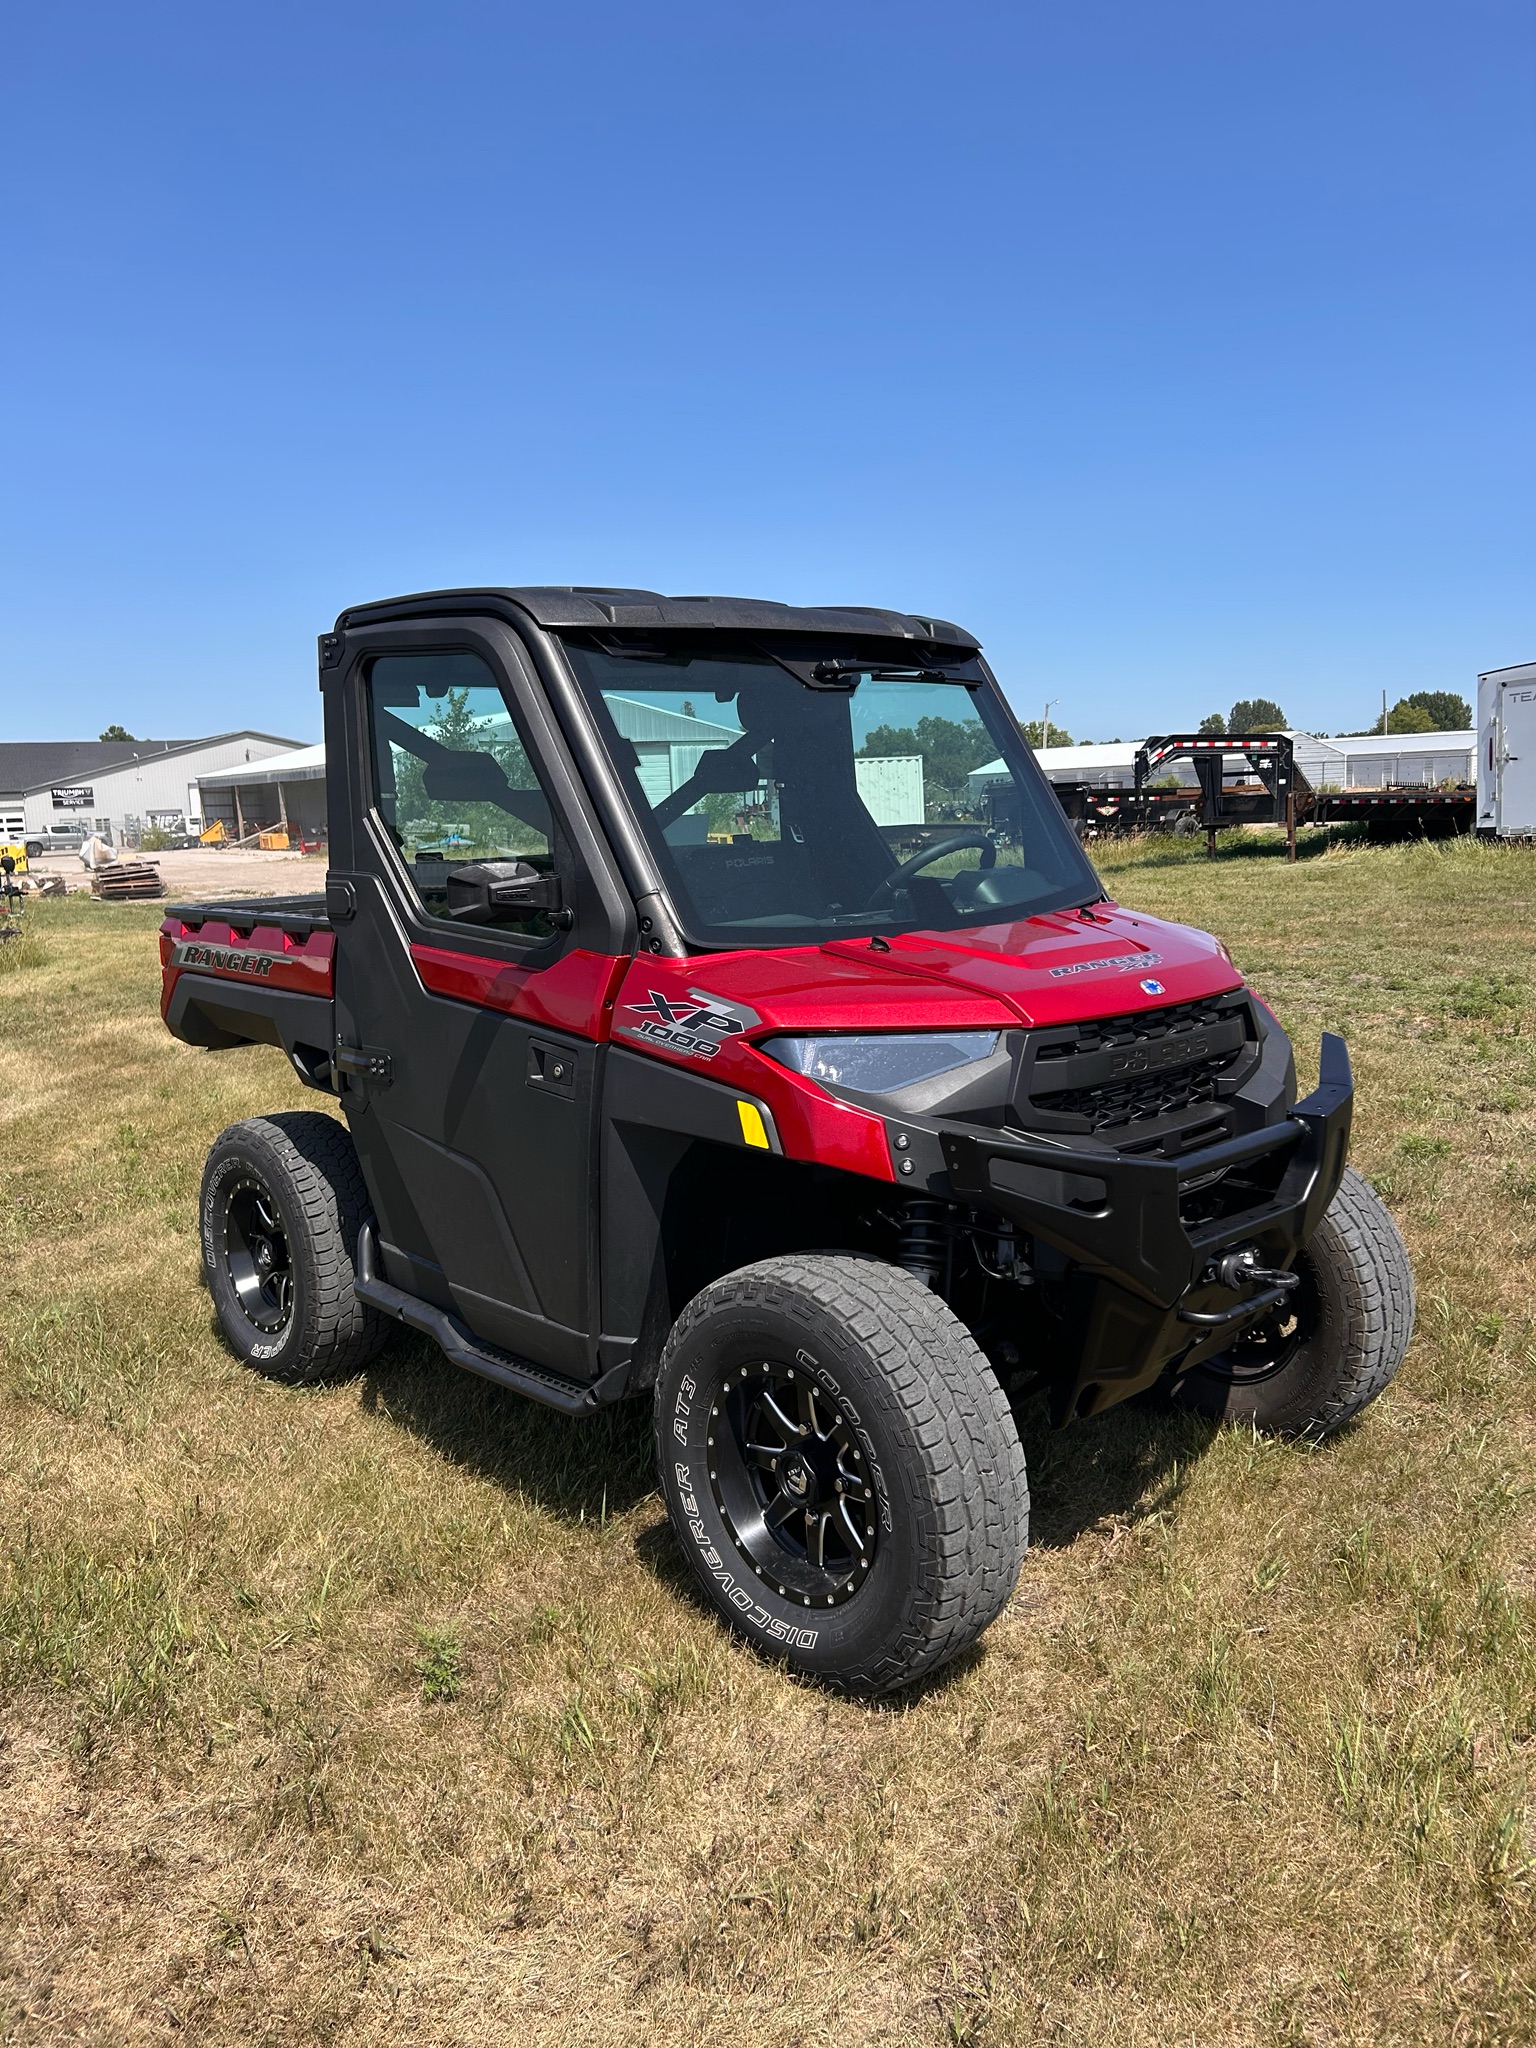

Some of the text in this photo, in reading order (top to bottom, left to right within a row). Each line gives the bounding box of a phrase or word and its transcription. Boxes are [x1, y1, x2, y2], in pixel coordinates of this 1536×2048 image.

[52, 788, 85, 798] TRIUMPH
[725, 856, 774, 869] POLARIS
[182, 945, 274, 977] RANGER
[1049, 952, 1163, 978] RANGER
[622, 989, 746, 1036] XP
[637, 1033, 656, 1043] DUAL
[640, 1020, 722, 1058] 1000
[1110, 1033, 1208, 1078] POLARIS
[673, 1374, 697, 1447] AT3
[796, 1348, 893, 1533] COOPER
[675, 1462, 819, 1650] DISCOVERER
